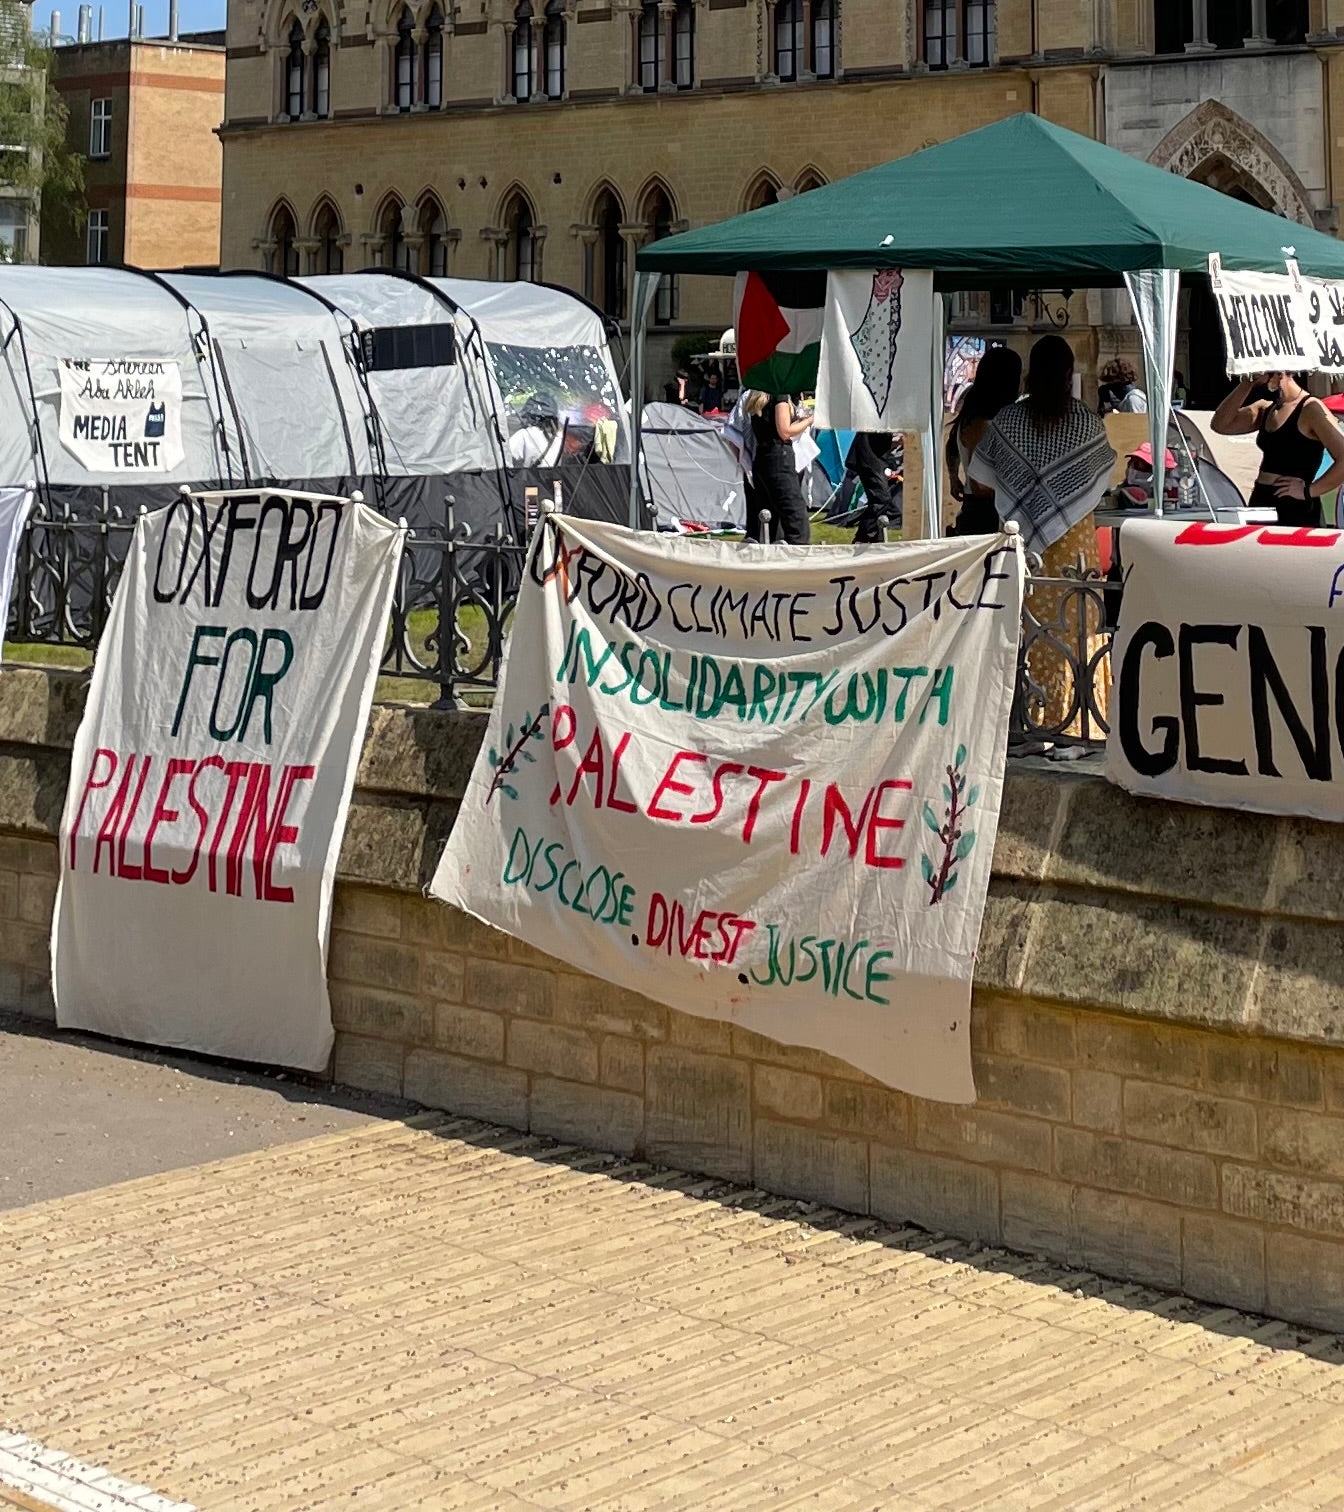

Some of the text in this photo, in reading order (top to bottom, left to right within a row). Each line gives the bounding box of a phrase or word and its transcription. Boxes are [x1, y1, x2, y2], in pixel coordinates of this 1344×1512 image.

[1219, 293, 1305, 359] WELCOME
[73, 415, 127, 441] MEDIA
[78, 376, 111, 400] Abu
[108, 441, 160, 467] TENT
[155, 495, 345, 611] OXFORD
[529, 520, 1018, 643] OXFORD CLIMATE JUSTICE
[171, 624, 295, 745] FOR
[69, 747, 316, 904] PALESTINE
[549, 704, 913, 869] PALESTINE
[750, 923, 895, 1005] JUSTICE
